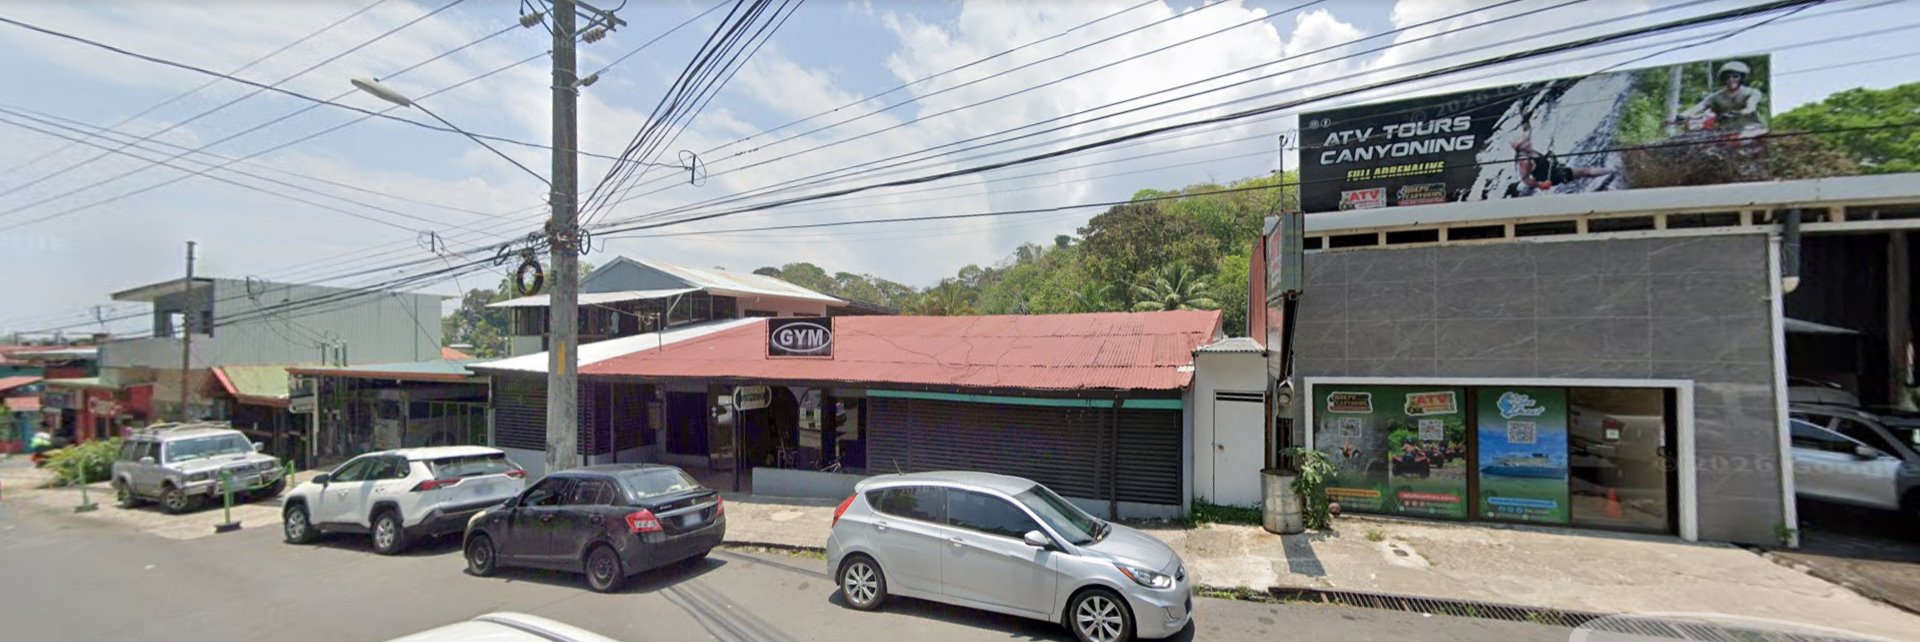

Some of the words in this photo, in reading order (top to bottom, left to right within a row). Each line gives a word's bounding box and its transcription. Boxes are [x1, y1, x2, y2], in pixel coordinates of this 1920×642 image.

[1323, 127, 1374, 147] ATV
[1383, 116, 1471, 139] TOURS
[1320, 135, 1475, 165] CANYONING
[1347, 169, 1371, 181] FULL
[1373, 161, 1445, 178] ADRENALINE
[1350, 189, 1380, 202] ATV
[780, 329, 823, 346] GYM
[1413, 394, 1448, 406] ATV
